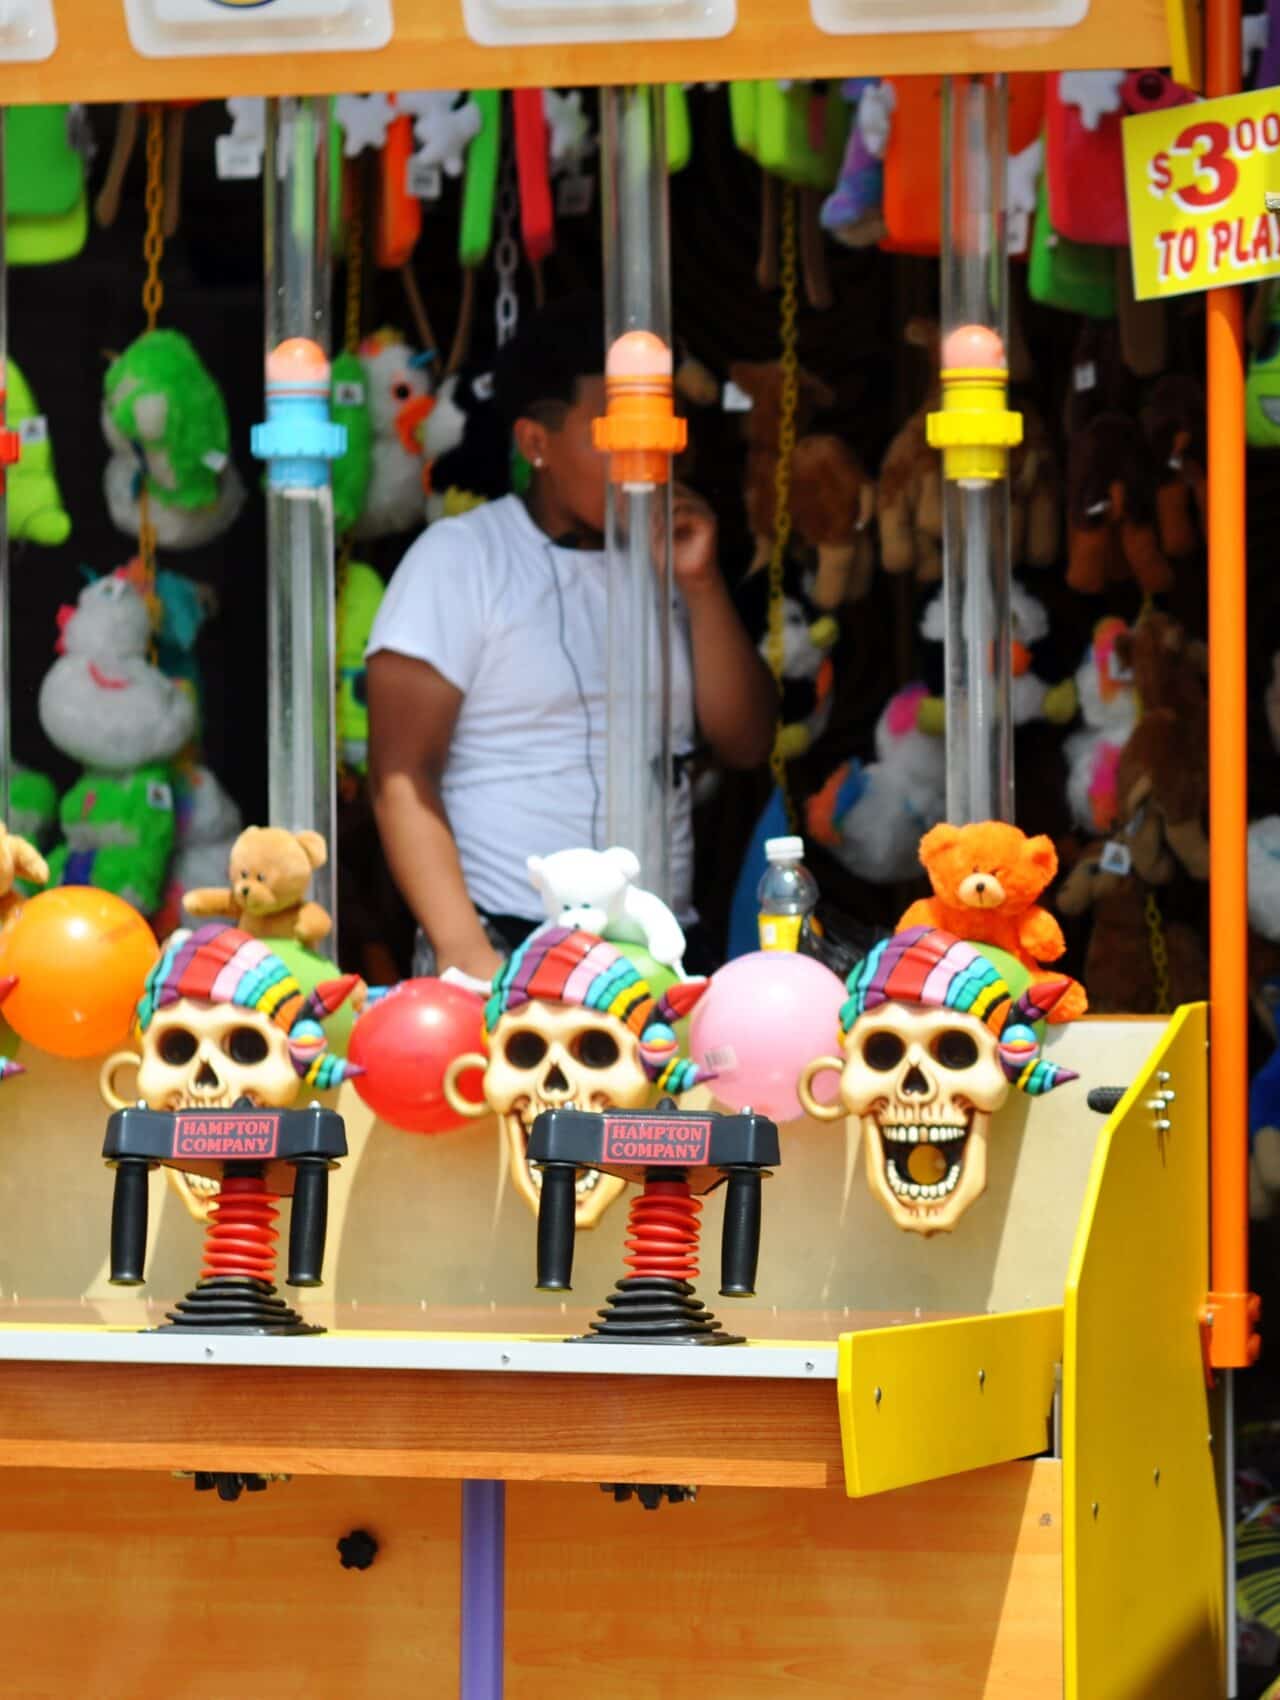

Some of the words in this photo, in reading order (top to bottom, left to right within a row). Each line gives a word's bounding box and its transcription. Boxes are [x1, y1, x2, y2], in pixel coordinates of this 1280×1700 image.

[1157, 226, 1198, 281] TO
[183, 1121, 271, 1136] HAMPTON
[612, 1125, 703, 1141] HAMPTON
[181, 1138, 269, 1152] COMPANY
[611, 1142, 701, 1159] COMPANY
